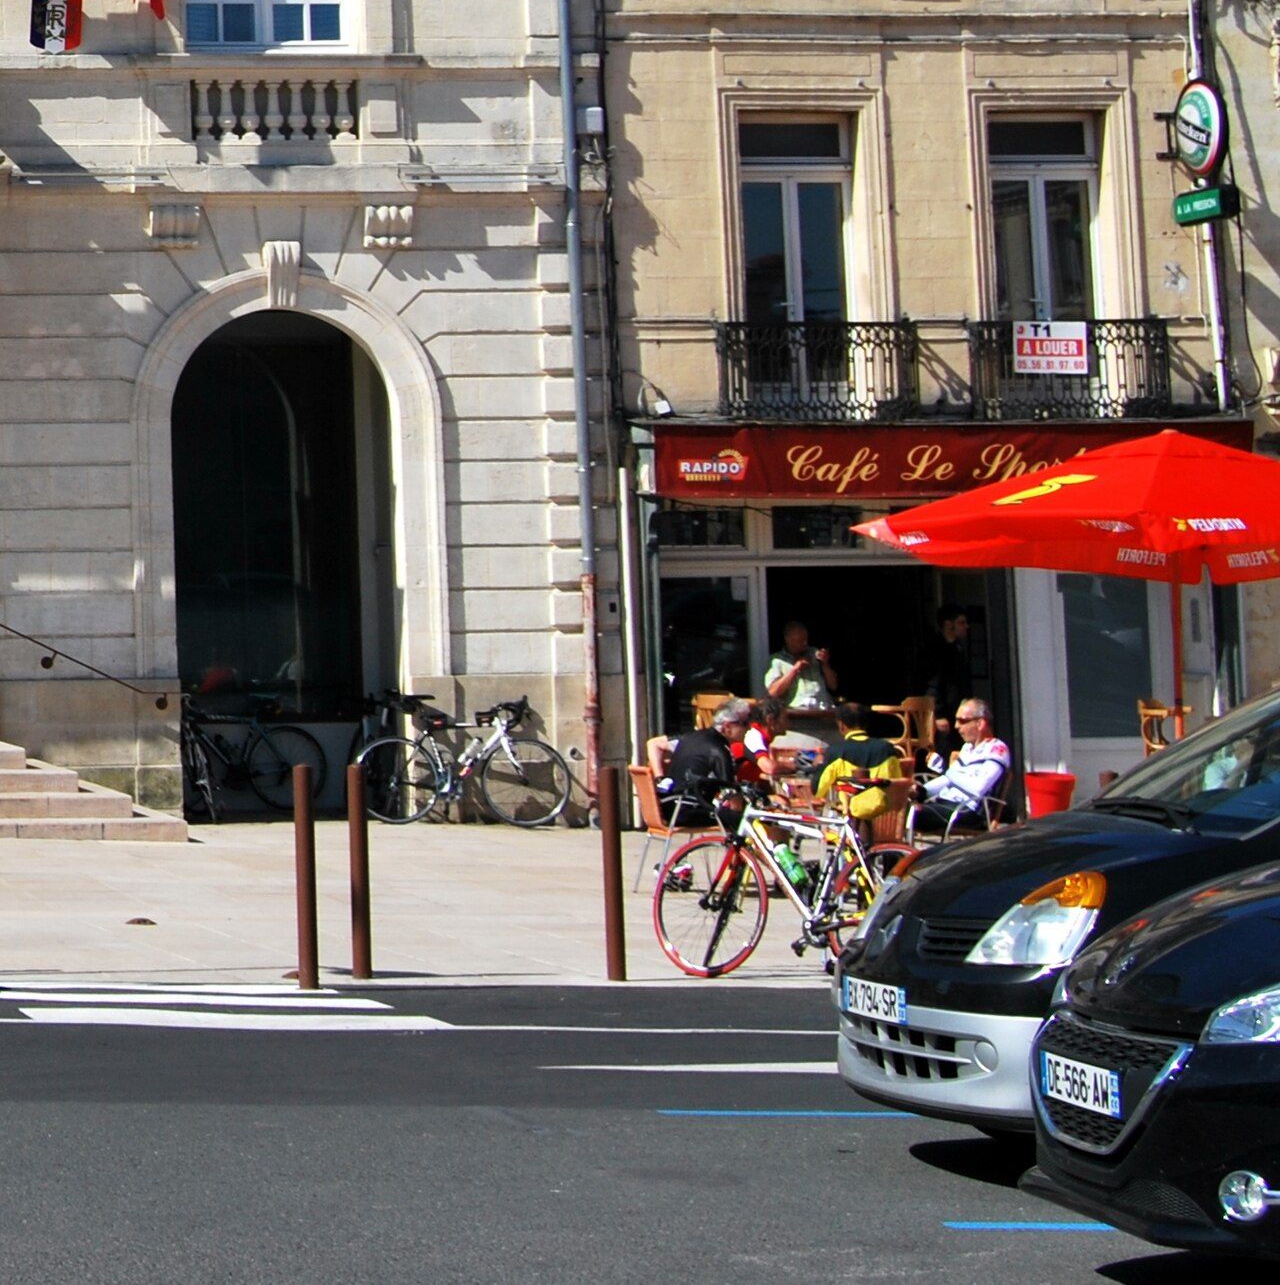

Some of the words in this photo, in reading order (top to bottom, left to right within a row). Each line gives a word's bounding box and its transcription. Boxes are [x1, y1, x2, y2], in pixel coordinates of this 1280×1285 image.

[1030, 324, 1051, 337] T1
[1022, 341, 1031, 354] A
[1035, 340, 1077, 355] LOUER
[680, 462, 740, 473] RAPIDO
[786, 445, 880, 493] Café
[900, 445, 955, 481] Le
[1047, 1058, 1109, 1110] DE-566-AW
